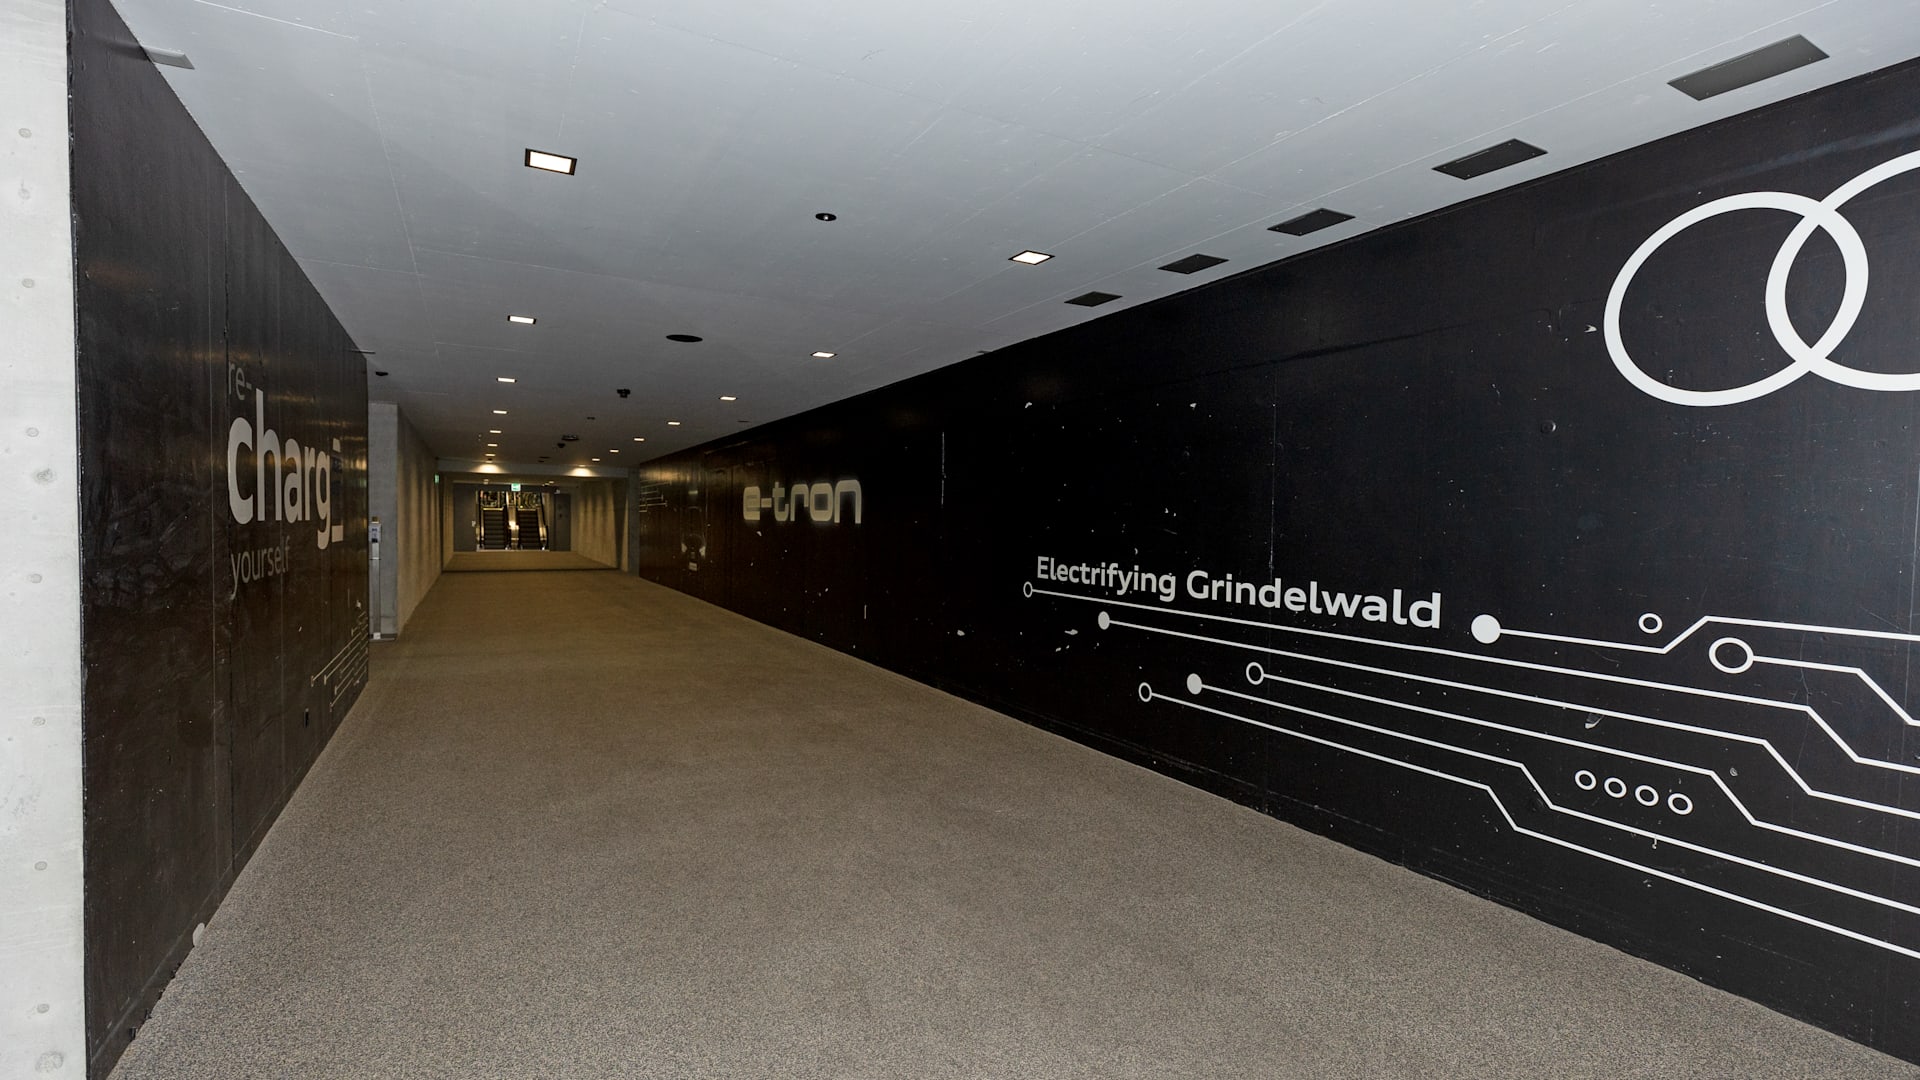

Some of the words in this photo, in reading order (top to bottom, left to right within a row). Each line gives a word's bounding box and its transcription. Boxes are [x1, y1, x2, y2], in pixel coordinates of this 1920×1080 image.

[228, 360, 253, 401] re-
[743, 479, 862, 524] e-tron
[231, 535, 291, 600] yourself
[1037, 555, 1176, 602] Electrifying
[1186, 570, 1441, 629] Grindelwald
